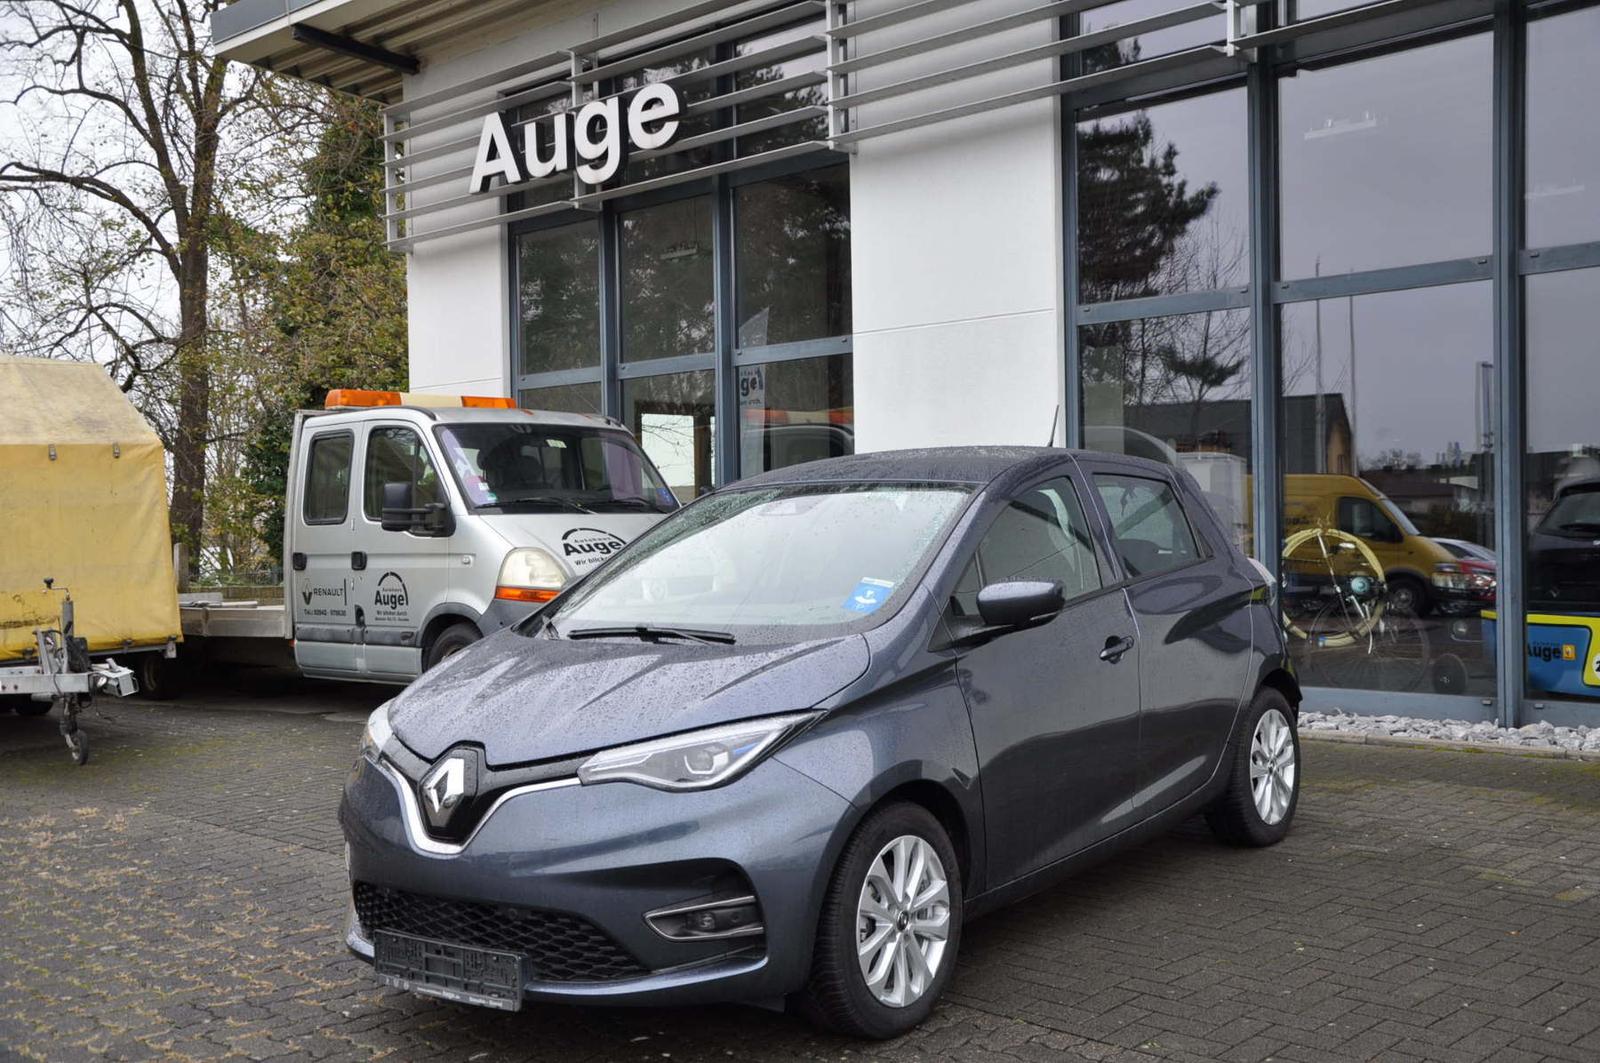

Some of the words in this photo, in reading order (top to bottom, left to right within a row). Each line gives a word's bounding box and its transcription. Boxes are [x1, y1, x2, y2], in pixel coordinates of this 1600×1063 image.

[469, 83, 680, 195] Auge
[563, 541, 622, 556] Auge
[313, 587, 344, 597] RENAULT
[375, 590, 405, 609] Auge
